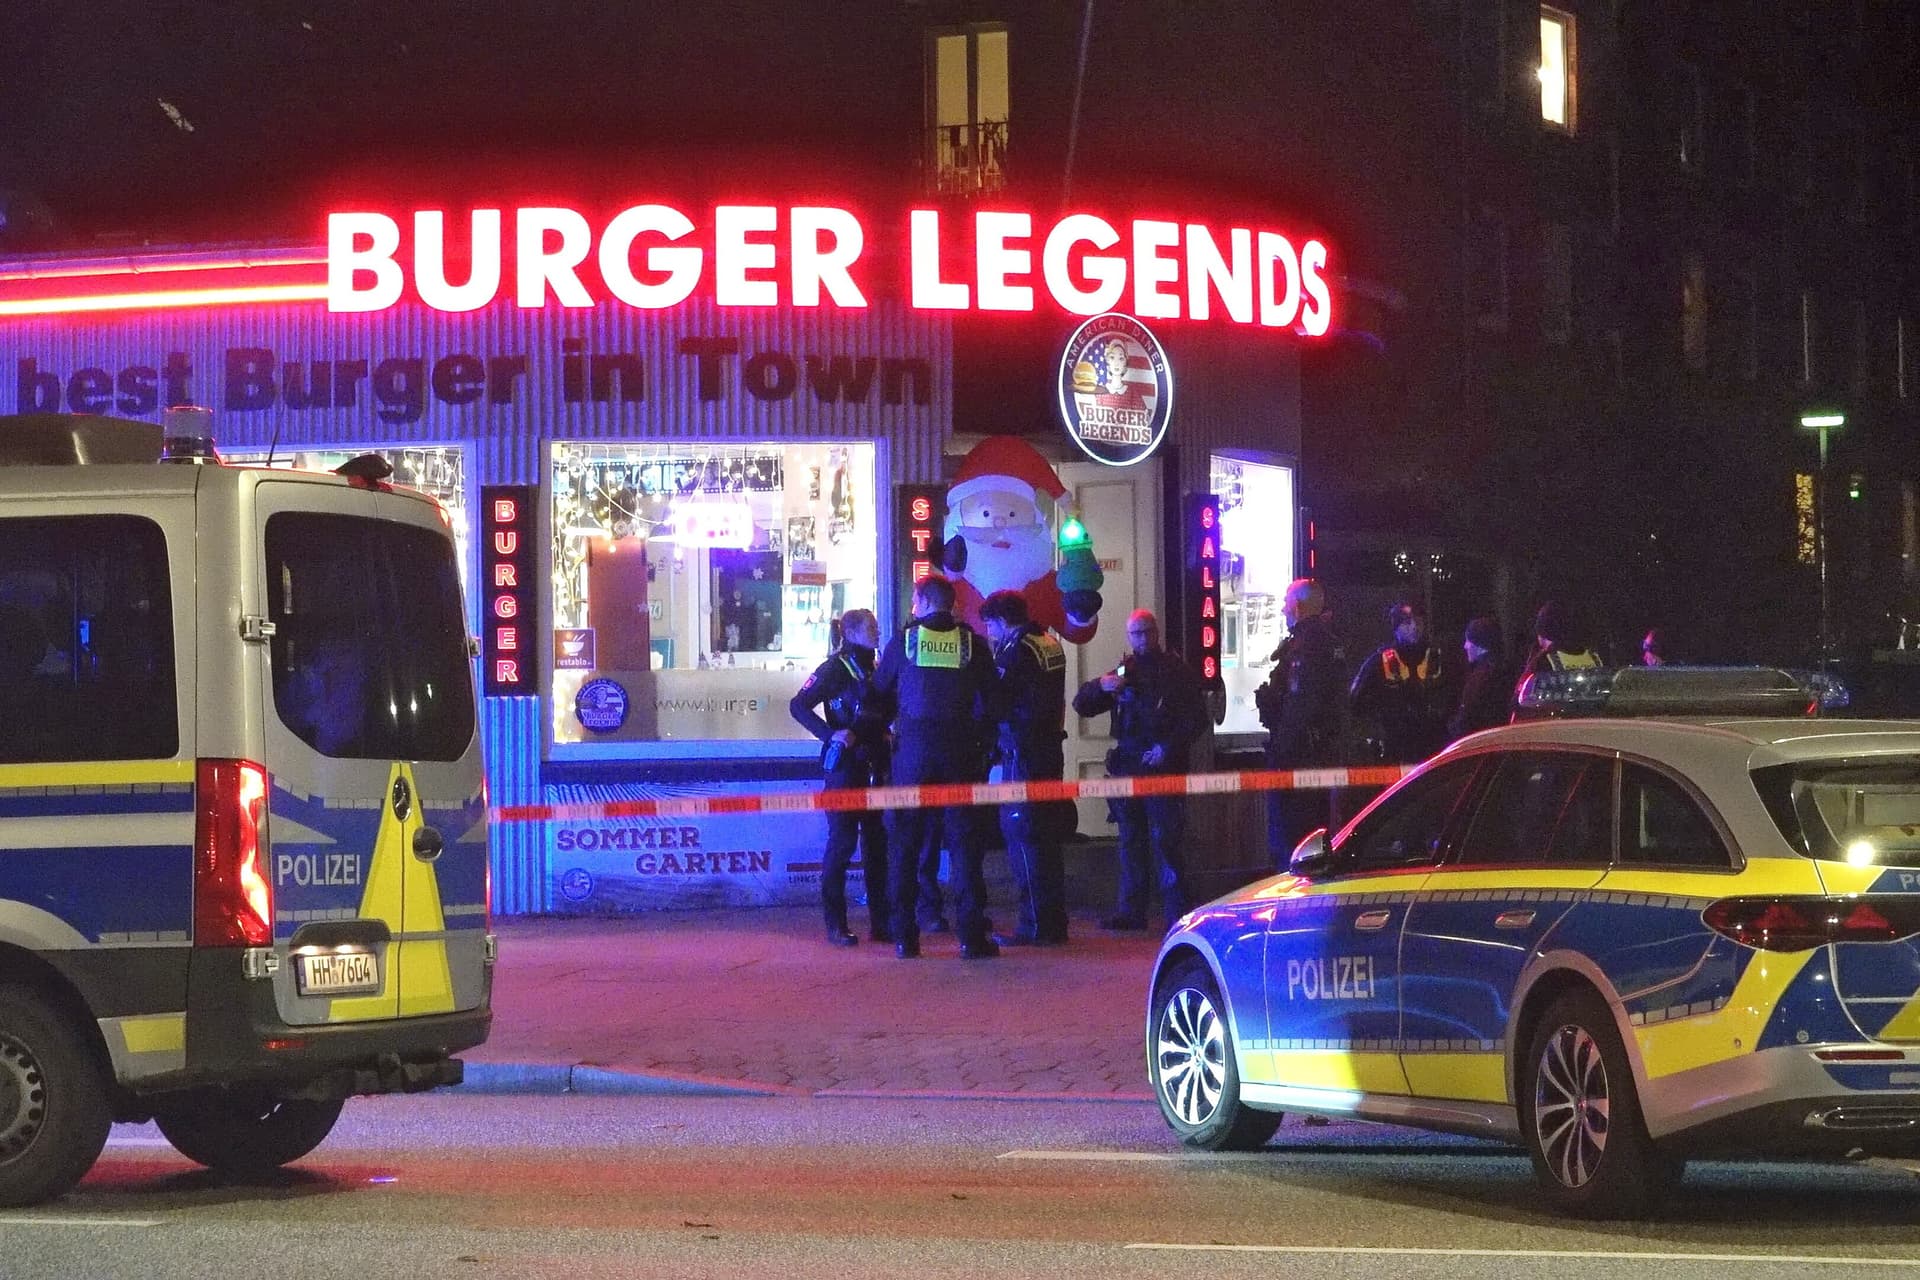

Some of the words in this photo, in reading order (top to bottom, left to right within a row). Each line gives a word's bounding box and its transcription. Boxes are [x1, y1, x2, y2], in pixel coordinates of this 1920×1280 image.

[328, 204, 867, 313] BURGER
[911, 210, 1331, 337] LEGENDS
[1067, 318, 1126, 369] AMERICAN
[1131, 327, 1164, 374] DINER
[18, 352, 194, 415] best
[225, 346, 528, 424] Burger
[563, 337, 644, 402] in
[680, 336, 931, 405] Town
[1081, 423, 1152, 444] LEGENDS
[1085, 407, 1147, 426] BURGER
[911, 498, 931, 586] STE
[494, 500, 518, 682] BURGER
[1202, 507, 1215, 678] SALADS
[920, 640, 958, 654] POLIZEI
[557, 827, 702, 851] SOMMER
[279, 854, 361, 886] POLIZEI
[635, 851, 772, 875] GARTEN
[311, 958, 332, 985] HH
[339, 956, 371, 984] 7604
[1287, 956, 1375, 1000] POLIZEI
